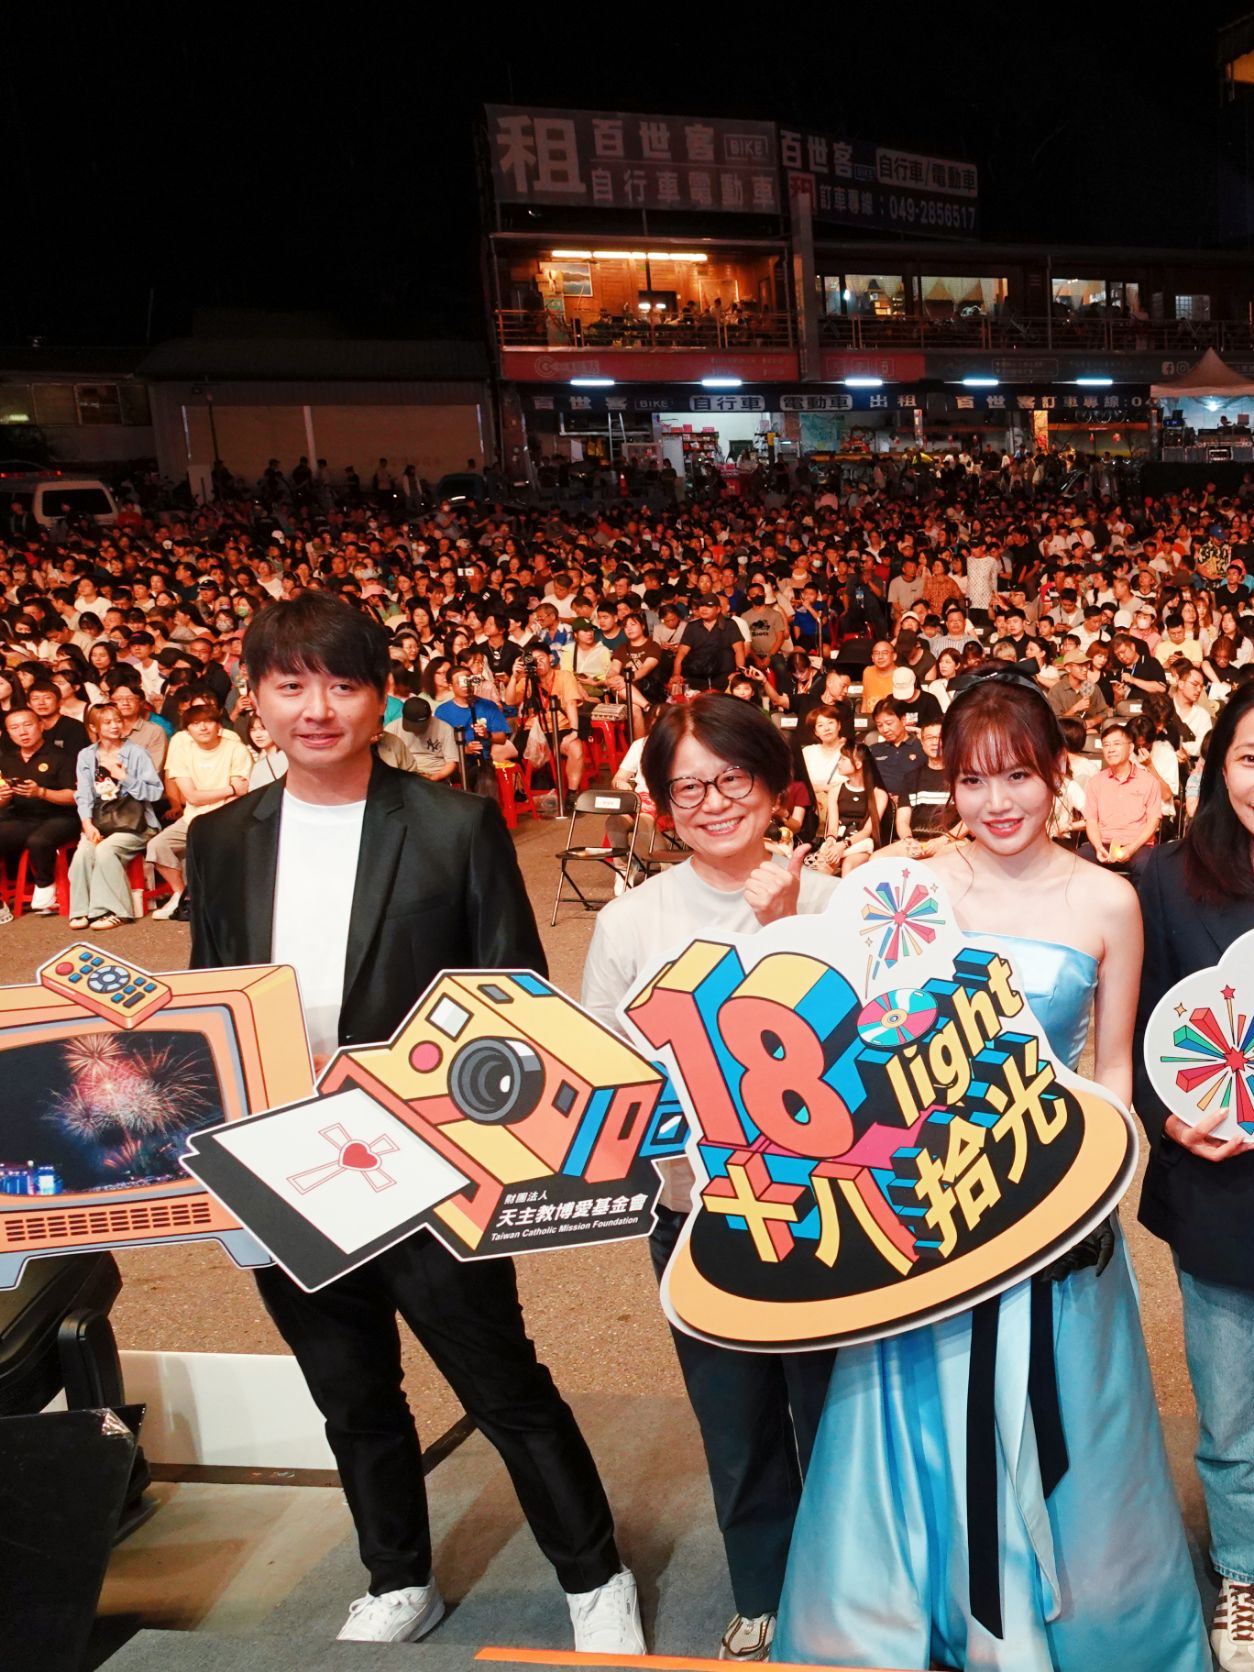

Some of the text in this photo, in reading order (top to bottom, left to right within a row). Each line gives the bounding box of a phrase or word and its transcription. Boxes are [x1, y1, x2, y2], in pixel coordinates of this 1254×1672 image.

[496, 115, 587, 194] 租
[591, 118, 764, 162] 百世客 BIKE
[780, 129, 853, 178] 百世客
[591, 168, 774, 208] 自行車電動車
[639, 399, 669, 409] BIKE
[694, 395, 762, 411] 自行車
[783, 395, 849, 410] 電動車
[869, 394, 917, 408] 出租
[625, 948, 1024, 1161] 18 light
[495, 1192, 649, 1228] 天主教博愛基金會
[504, 1190, 549, 1205] 財團法人
[491, 1216, 639, 1242] Taiwan Catholic Mission Foundation
